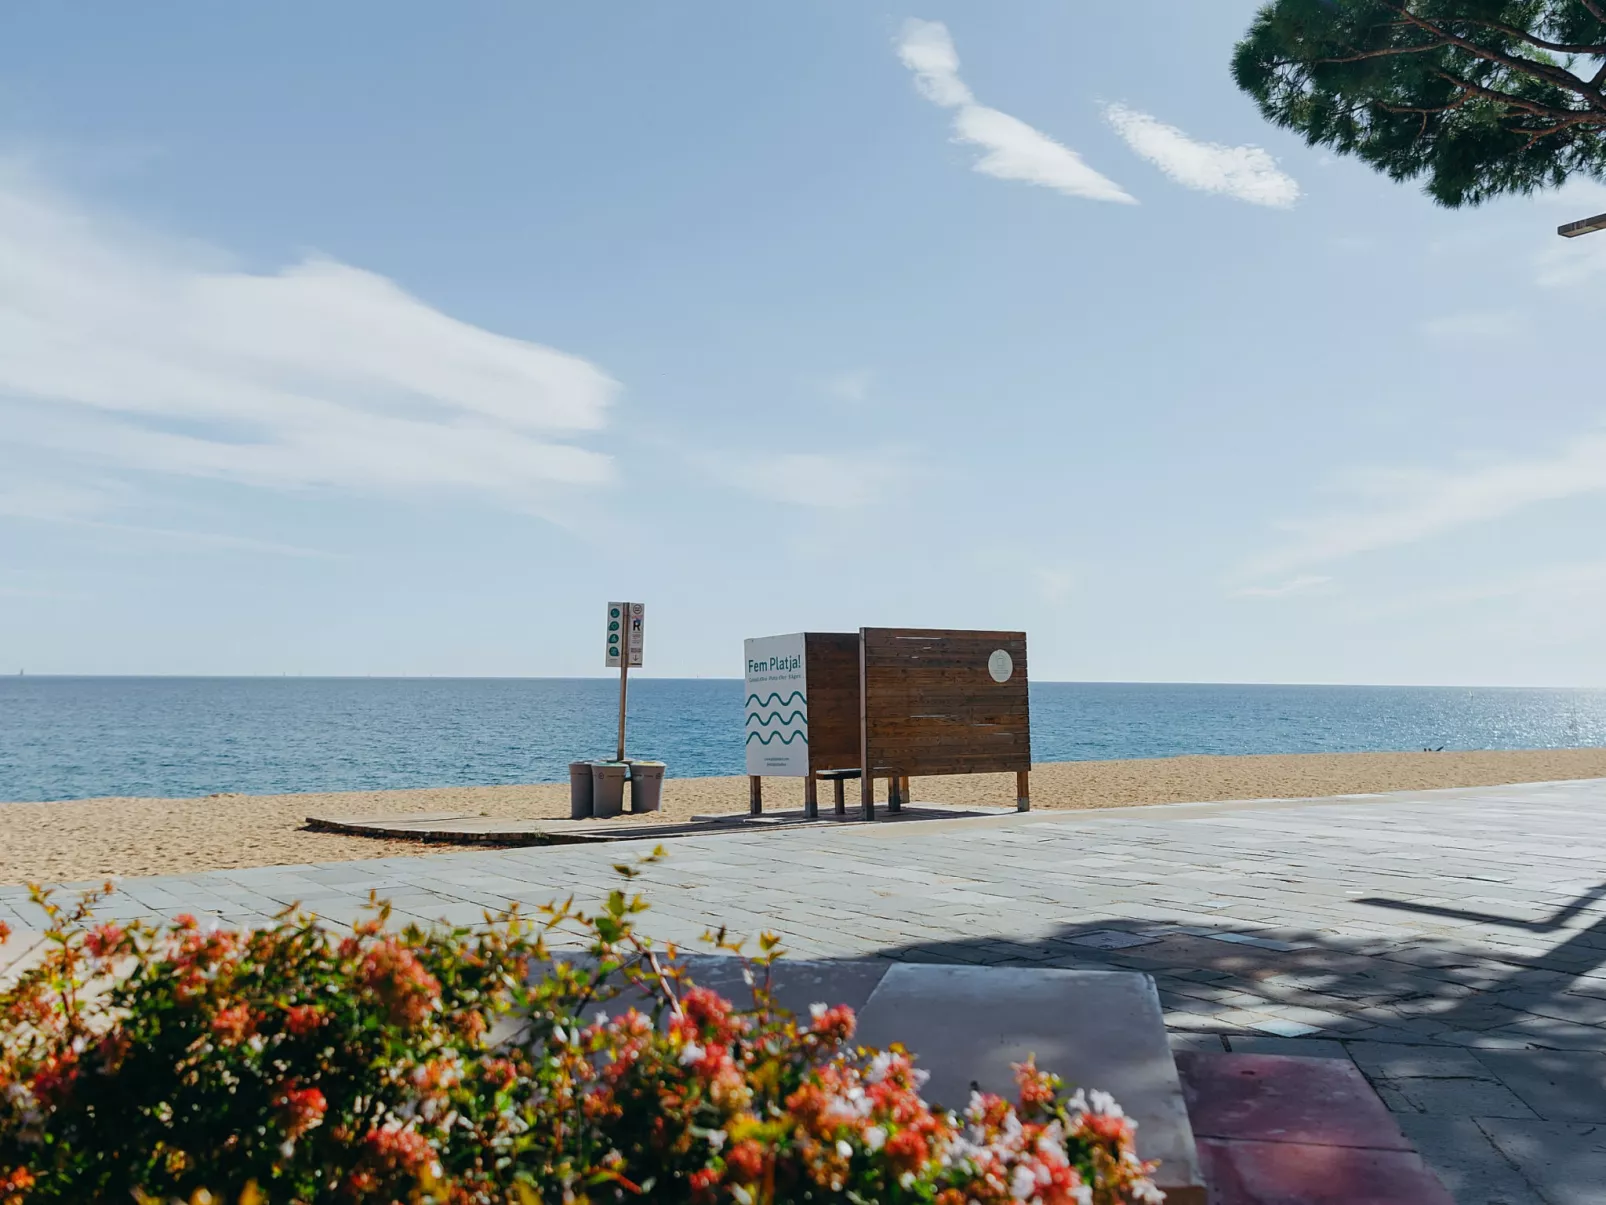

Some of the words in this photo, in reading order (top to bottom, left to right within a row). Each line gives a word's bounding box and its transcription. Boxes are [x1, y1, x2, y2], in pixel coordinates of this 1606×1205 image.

[633, 620, 641, 631] R
[748, 659, 768, 673] Fem
[770, 654, 801, 672] Platja!
